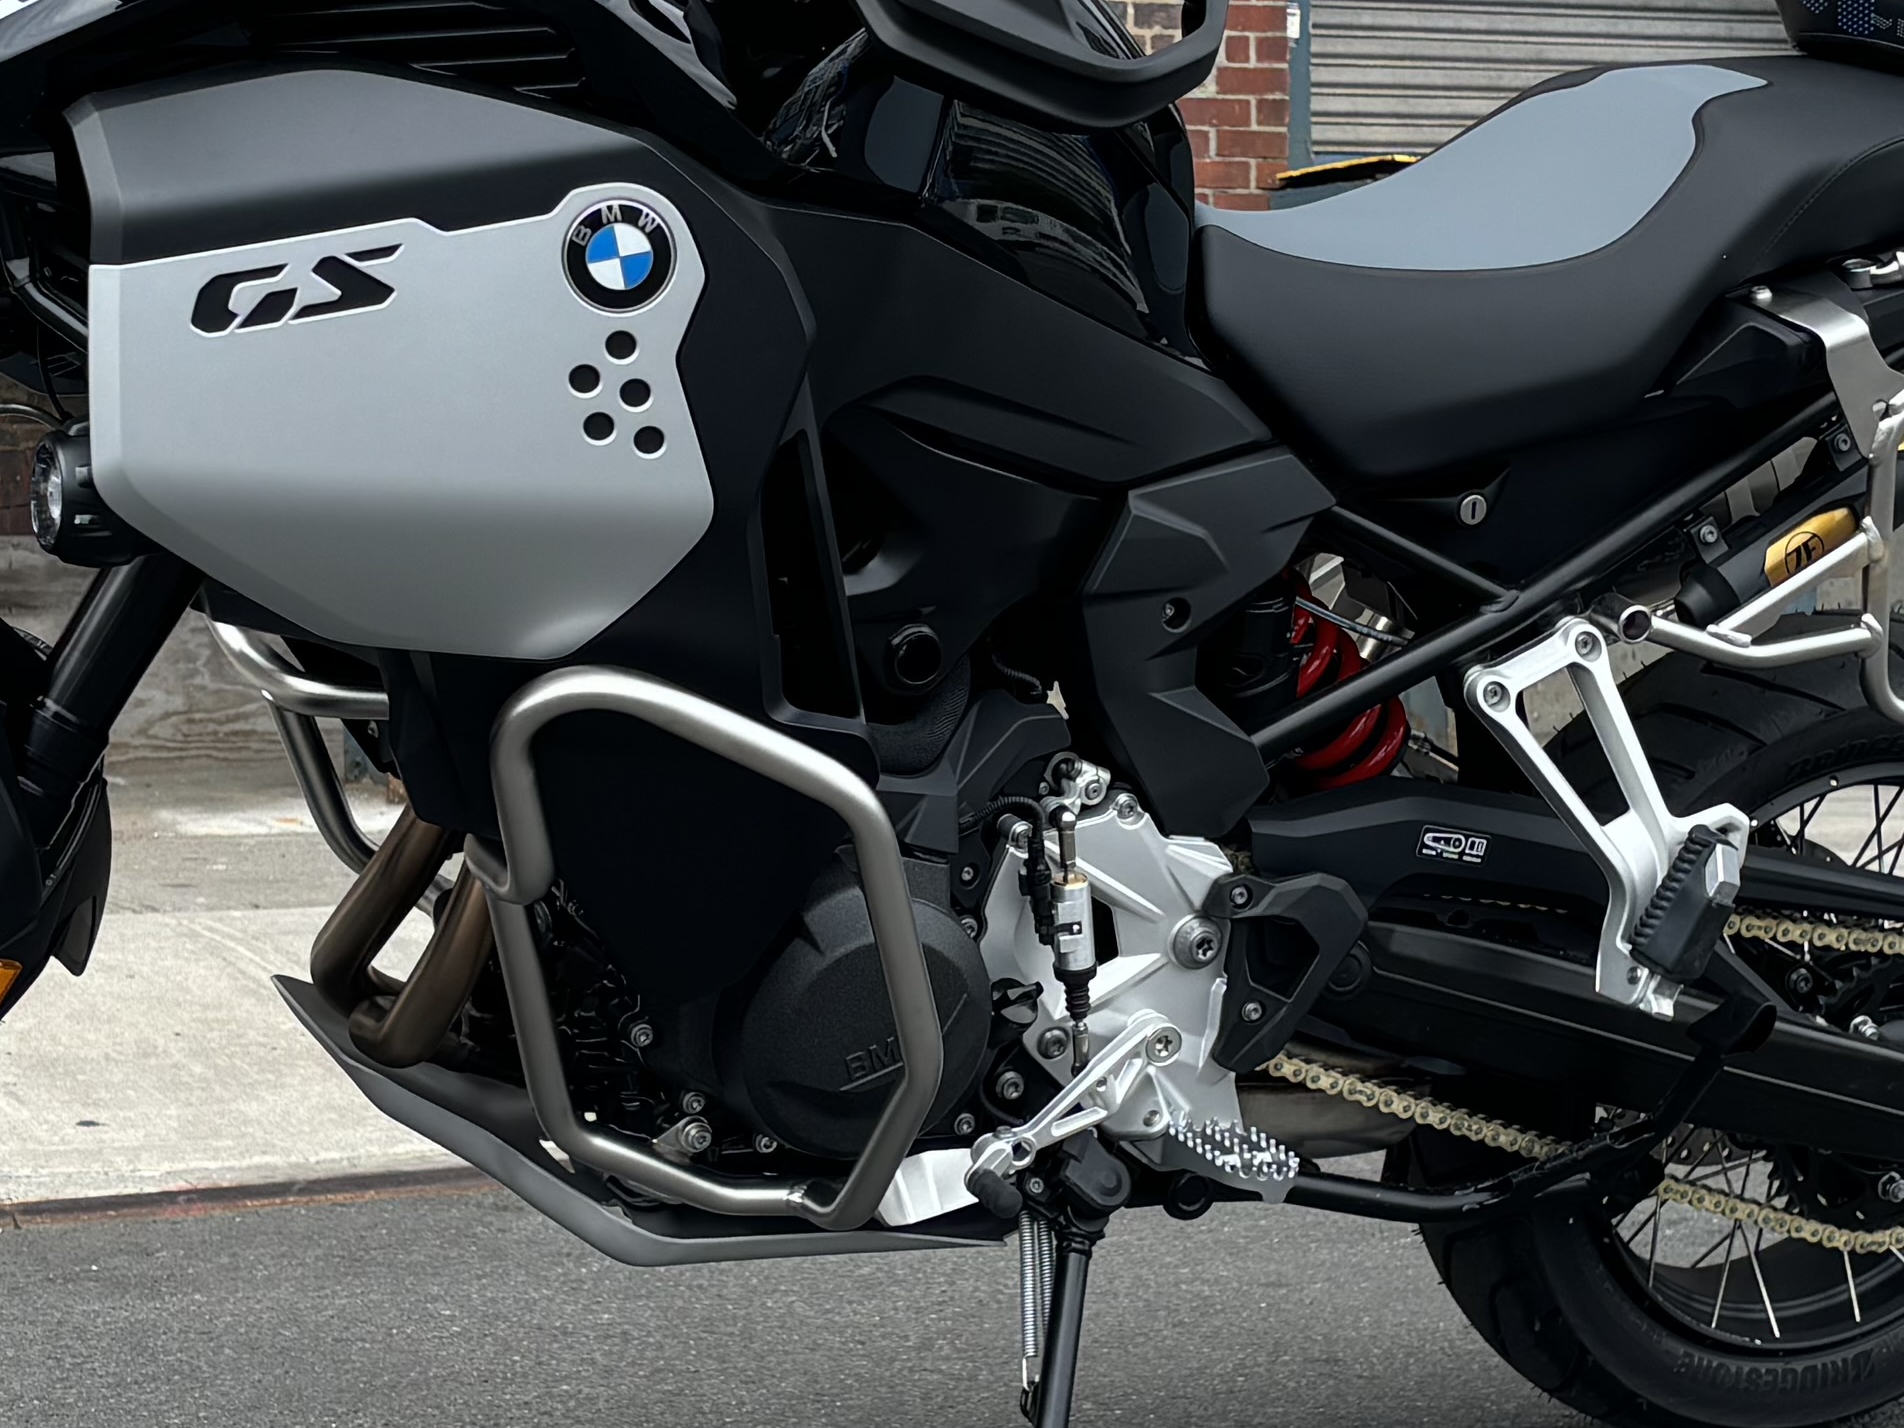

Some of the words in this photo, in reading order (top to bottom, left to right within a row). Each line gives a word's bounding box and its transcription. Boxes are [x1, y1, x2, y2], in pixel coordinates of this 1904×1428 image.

[571, 203, 660, 247] BMW
[190, 242, 405, 338] GS
[844, 1036, 899, 1083] BM
